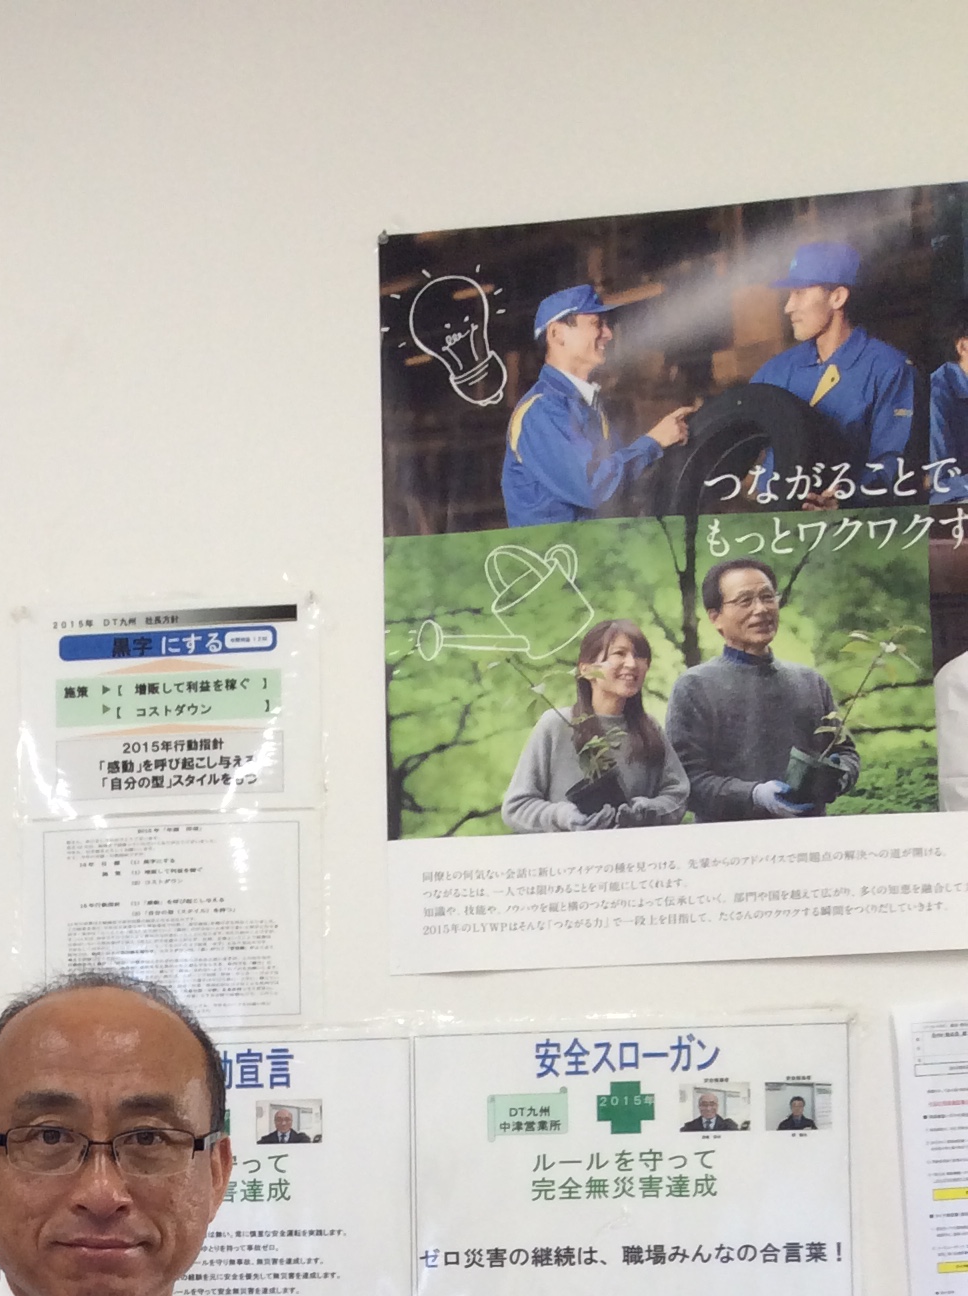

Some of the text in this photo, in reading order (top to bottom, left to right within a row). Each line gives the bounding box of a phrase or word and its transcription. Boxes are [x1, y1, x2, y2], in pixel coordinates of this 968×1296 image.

[52, 619, 94, 630] 2015年
[102, 617, 137, 627] DT九州
[136, 704, 212, 716] コストダウン
[123, 738, 224, 754] 2015年行動指針
[535, 1034, 720, 1078] 安全スローガン
[509, 1106, 551, 1118] DT九州
[499, 1119, 561, 1133] 中津営業所
[532, 1150, 715, 1172] ルールを守って
[532, 1175, 718, 1200] 完全無災害達成
